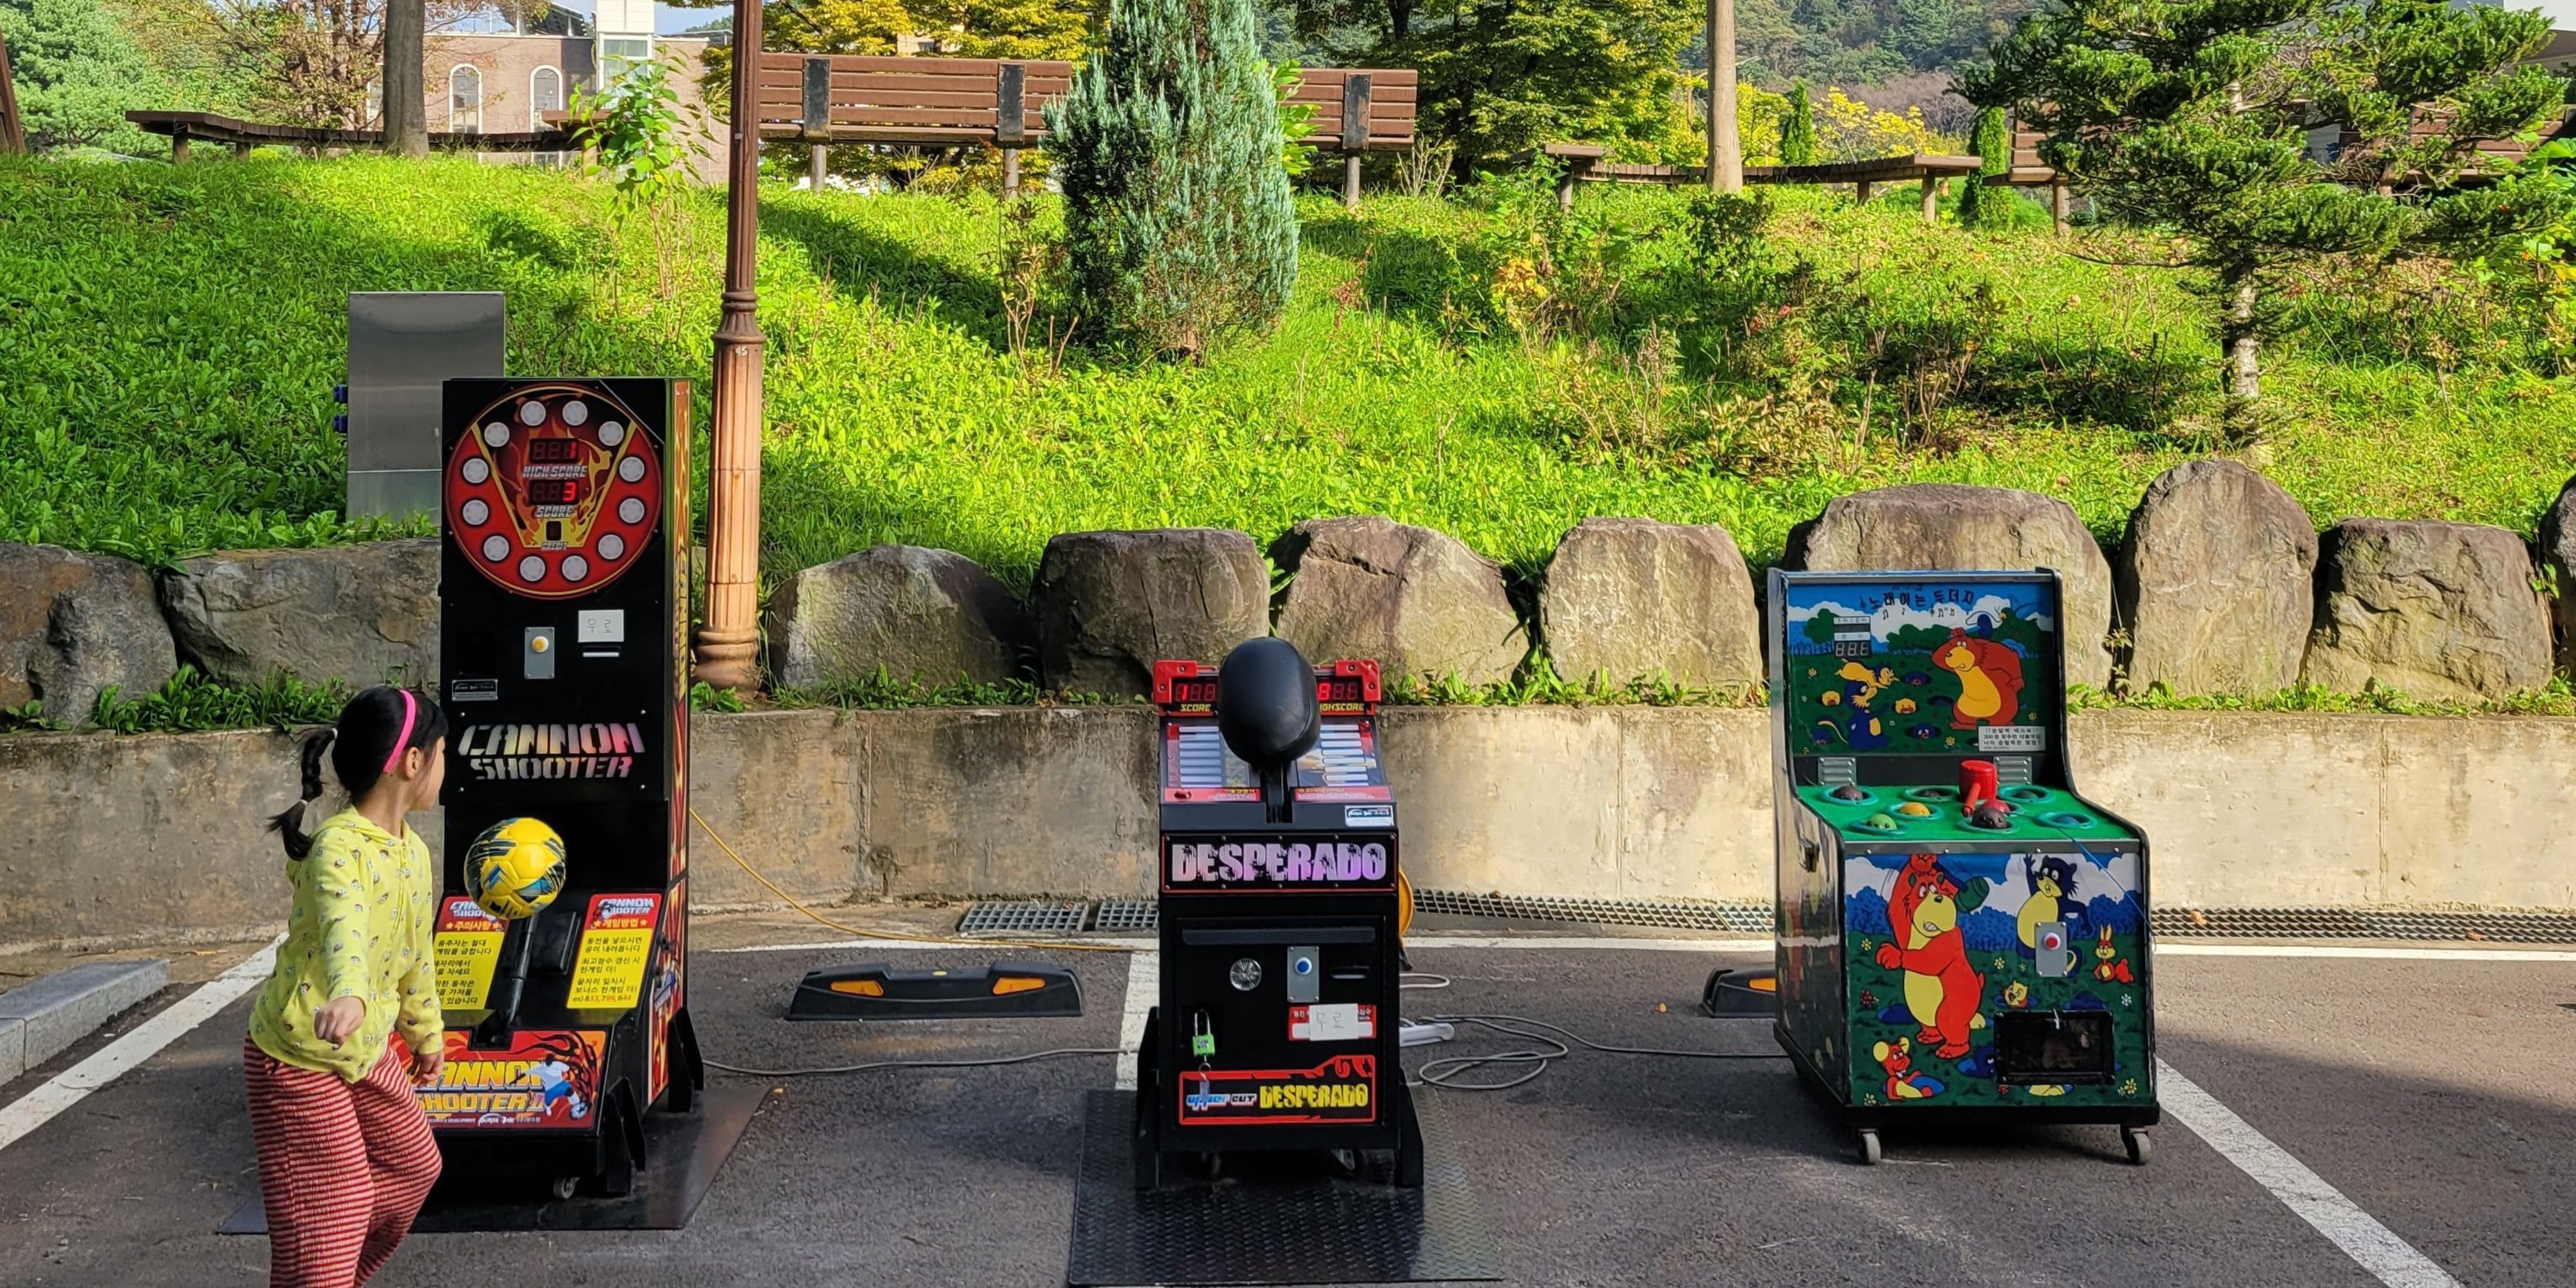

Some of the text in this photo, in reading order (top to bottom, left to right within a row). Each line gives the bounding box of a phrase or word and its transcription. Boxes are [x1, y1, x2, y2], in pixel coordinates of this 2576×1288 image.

[522, 465, 587, 478] HIGH SCORE
[535, 506, 573, 518] SCORE
[1934, 588, 1974, 605] 두더지
[587, 619, 612, 633] 무료
[1181, 703, 1212, 712] SCORE
[458, 723, 646, 756] CANNON
[470, 757, 633, 780] SHOOTER
[1171, 843, 1387, 883] DESPERADO
[454, 921, 491, 931] 주의사항
[602, 918, 638, 927] 게임방법
[1317, 1011, 1344, 1032] 무료
[1260, 1084, 1368, 1109] DESPERADO
